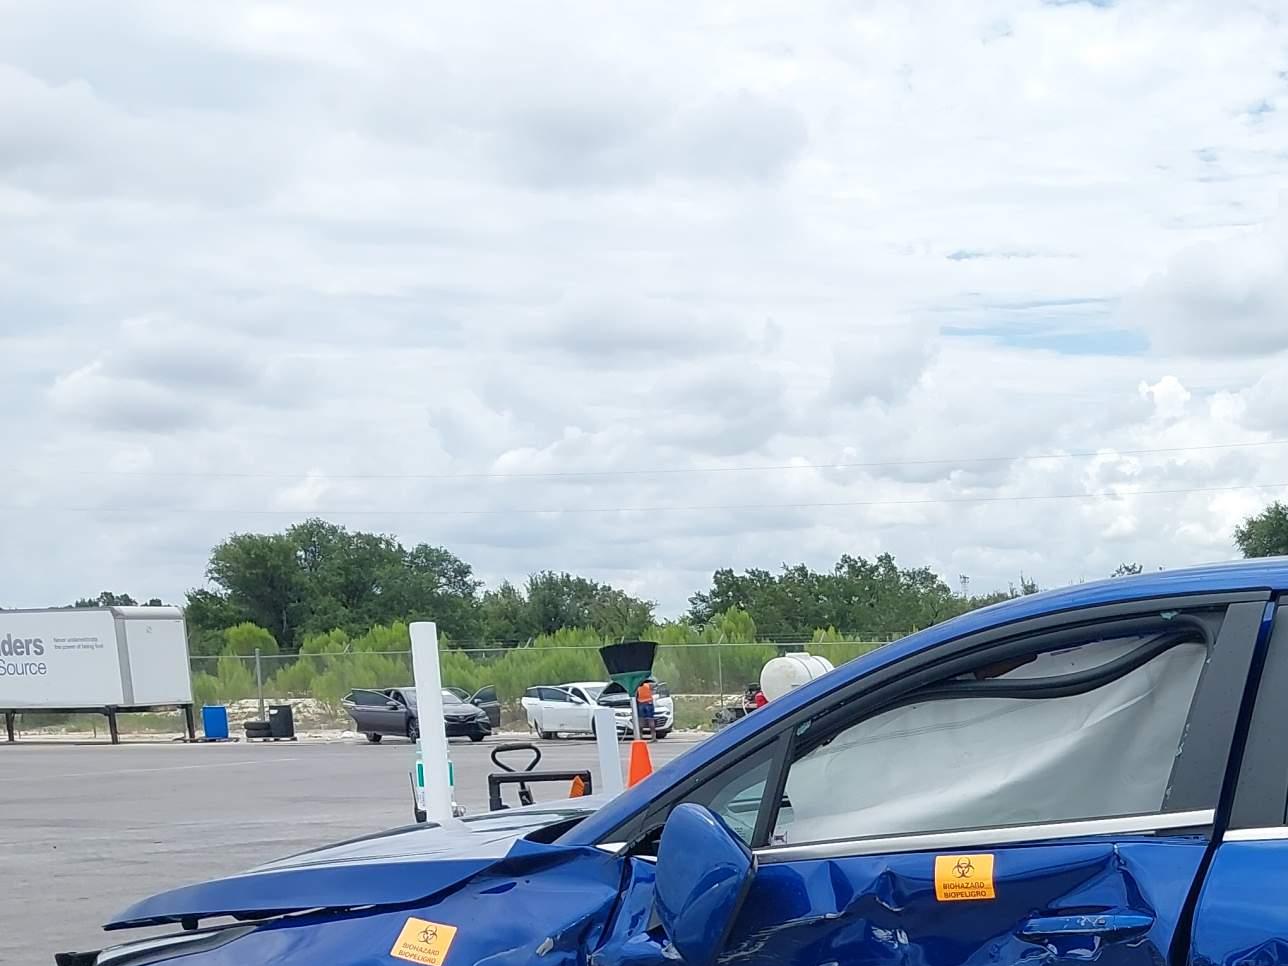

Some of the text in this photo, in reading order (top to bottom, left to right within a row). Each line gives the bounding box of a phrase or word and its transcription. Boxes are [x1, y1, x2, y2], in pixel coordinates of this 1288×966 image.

[0, 633, 44, 656] ders
[943, 882, 985, 890] BIOHAZARD
[402, 942, 440, 956] BIOHAZARD
[398, 949, 437, 964] BIOPELIGRO
